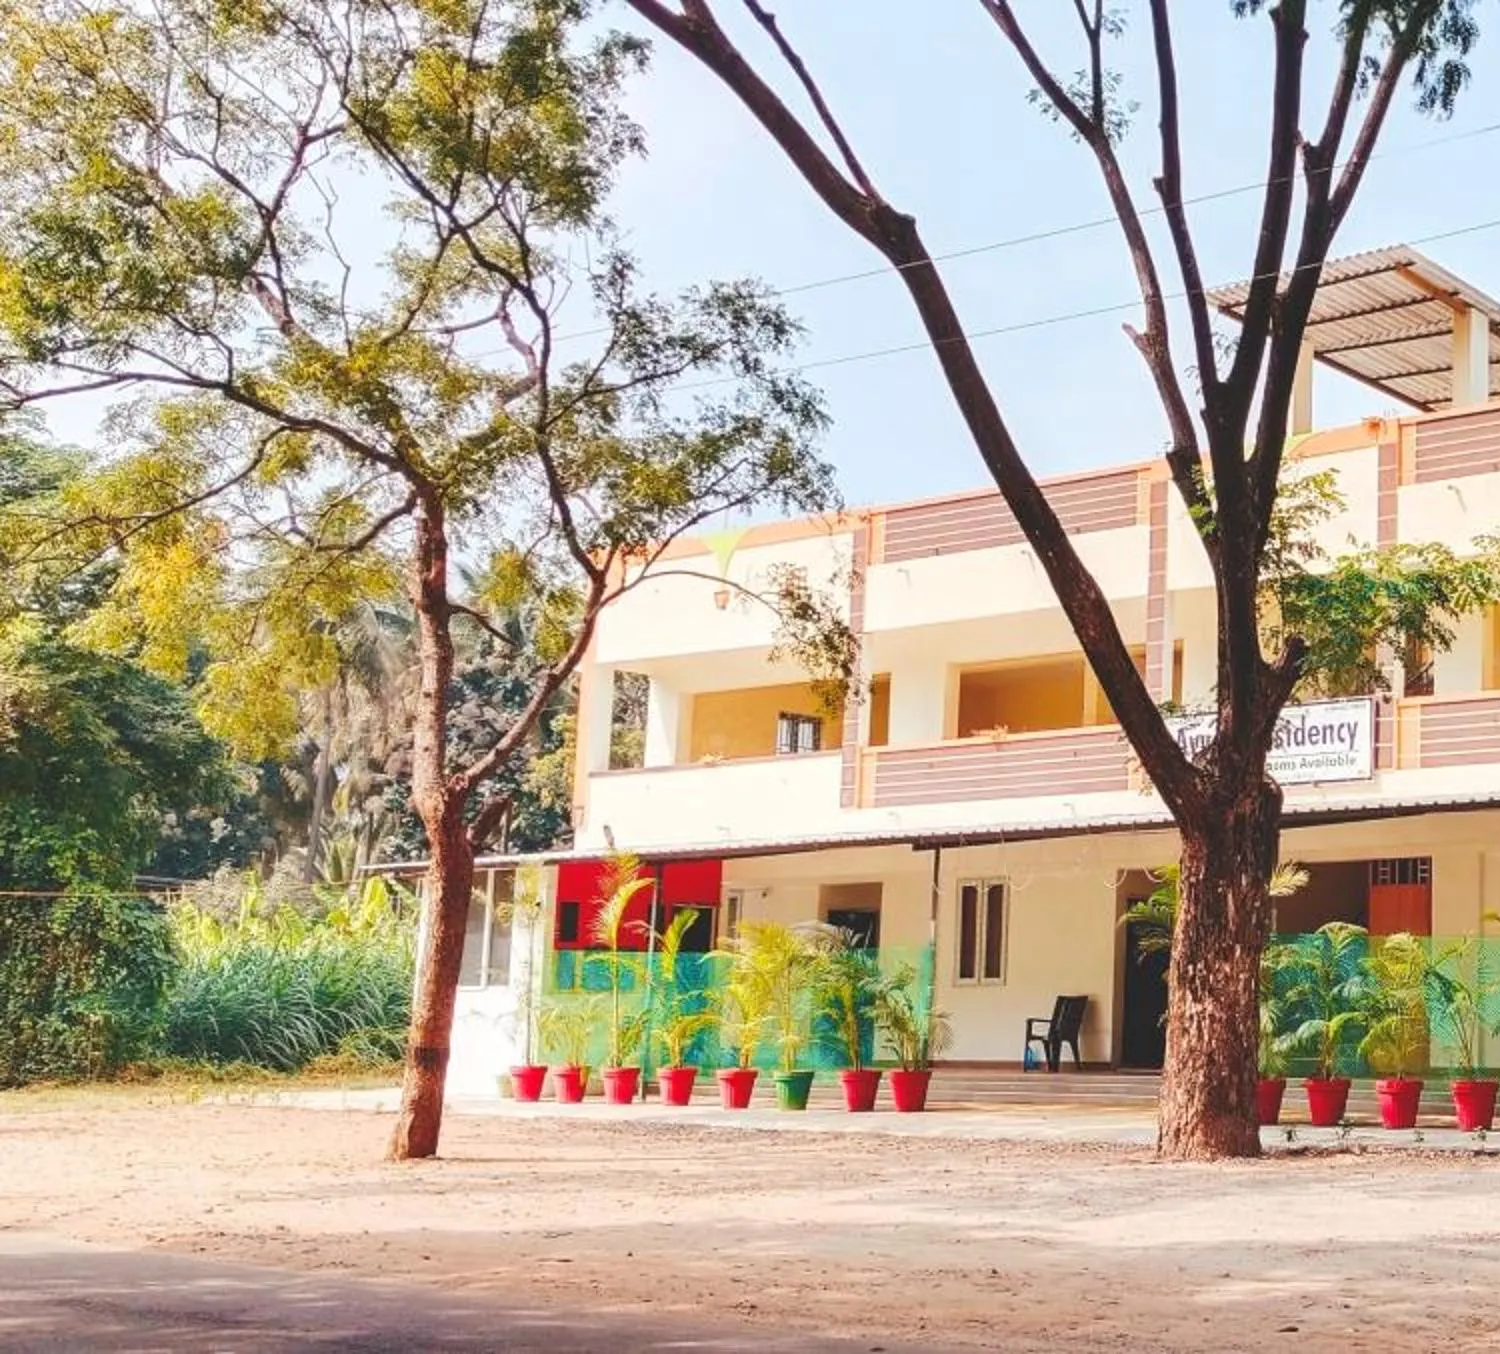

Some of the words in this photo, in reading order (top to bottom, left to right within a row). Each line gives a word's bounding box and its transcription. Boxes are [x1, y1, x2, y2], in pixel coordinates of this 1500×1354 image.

[1272, 713, 1358, 751] sidency
[1266, 761, 1296, 771] ooms
[1299, 754, 1357, 769] Available
